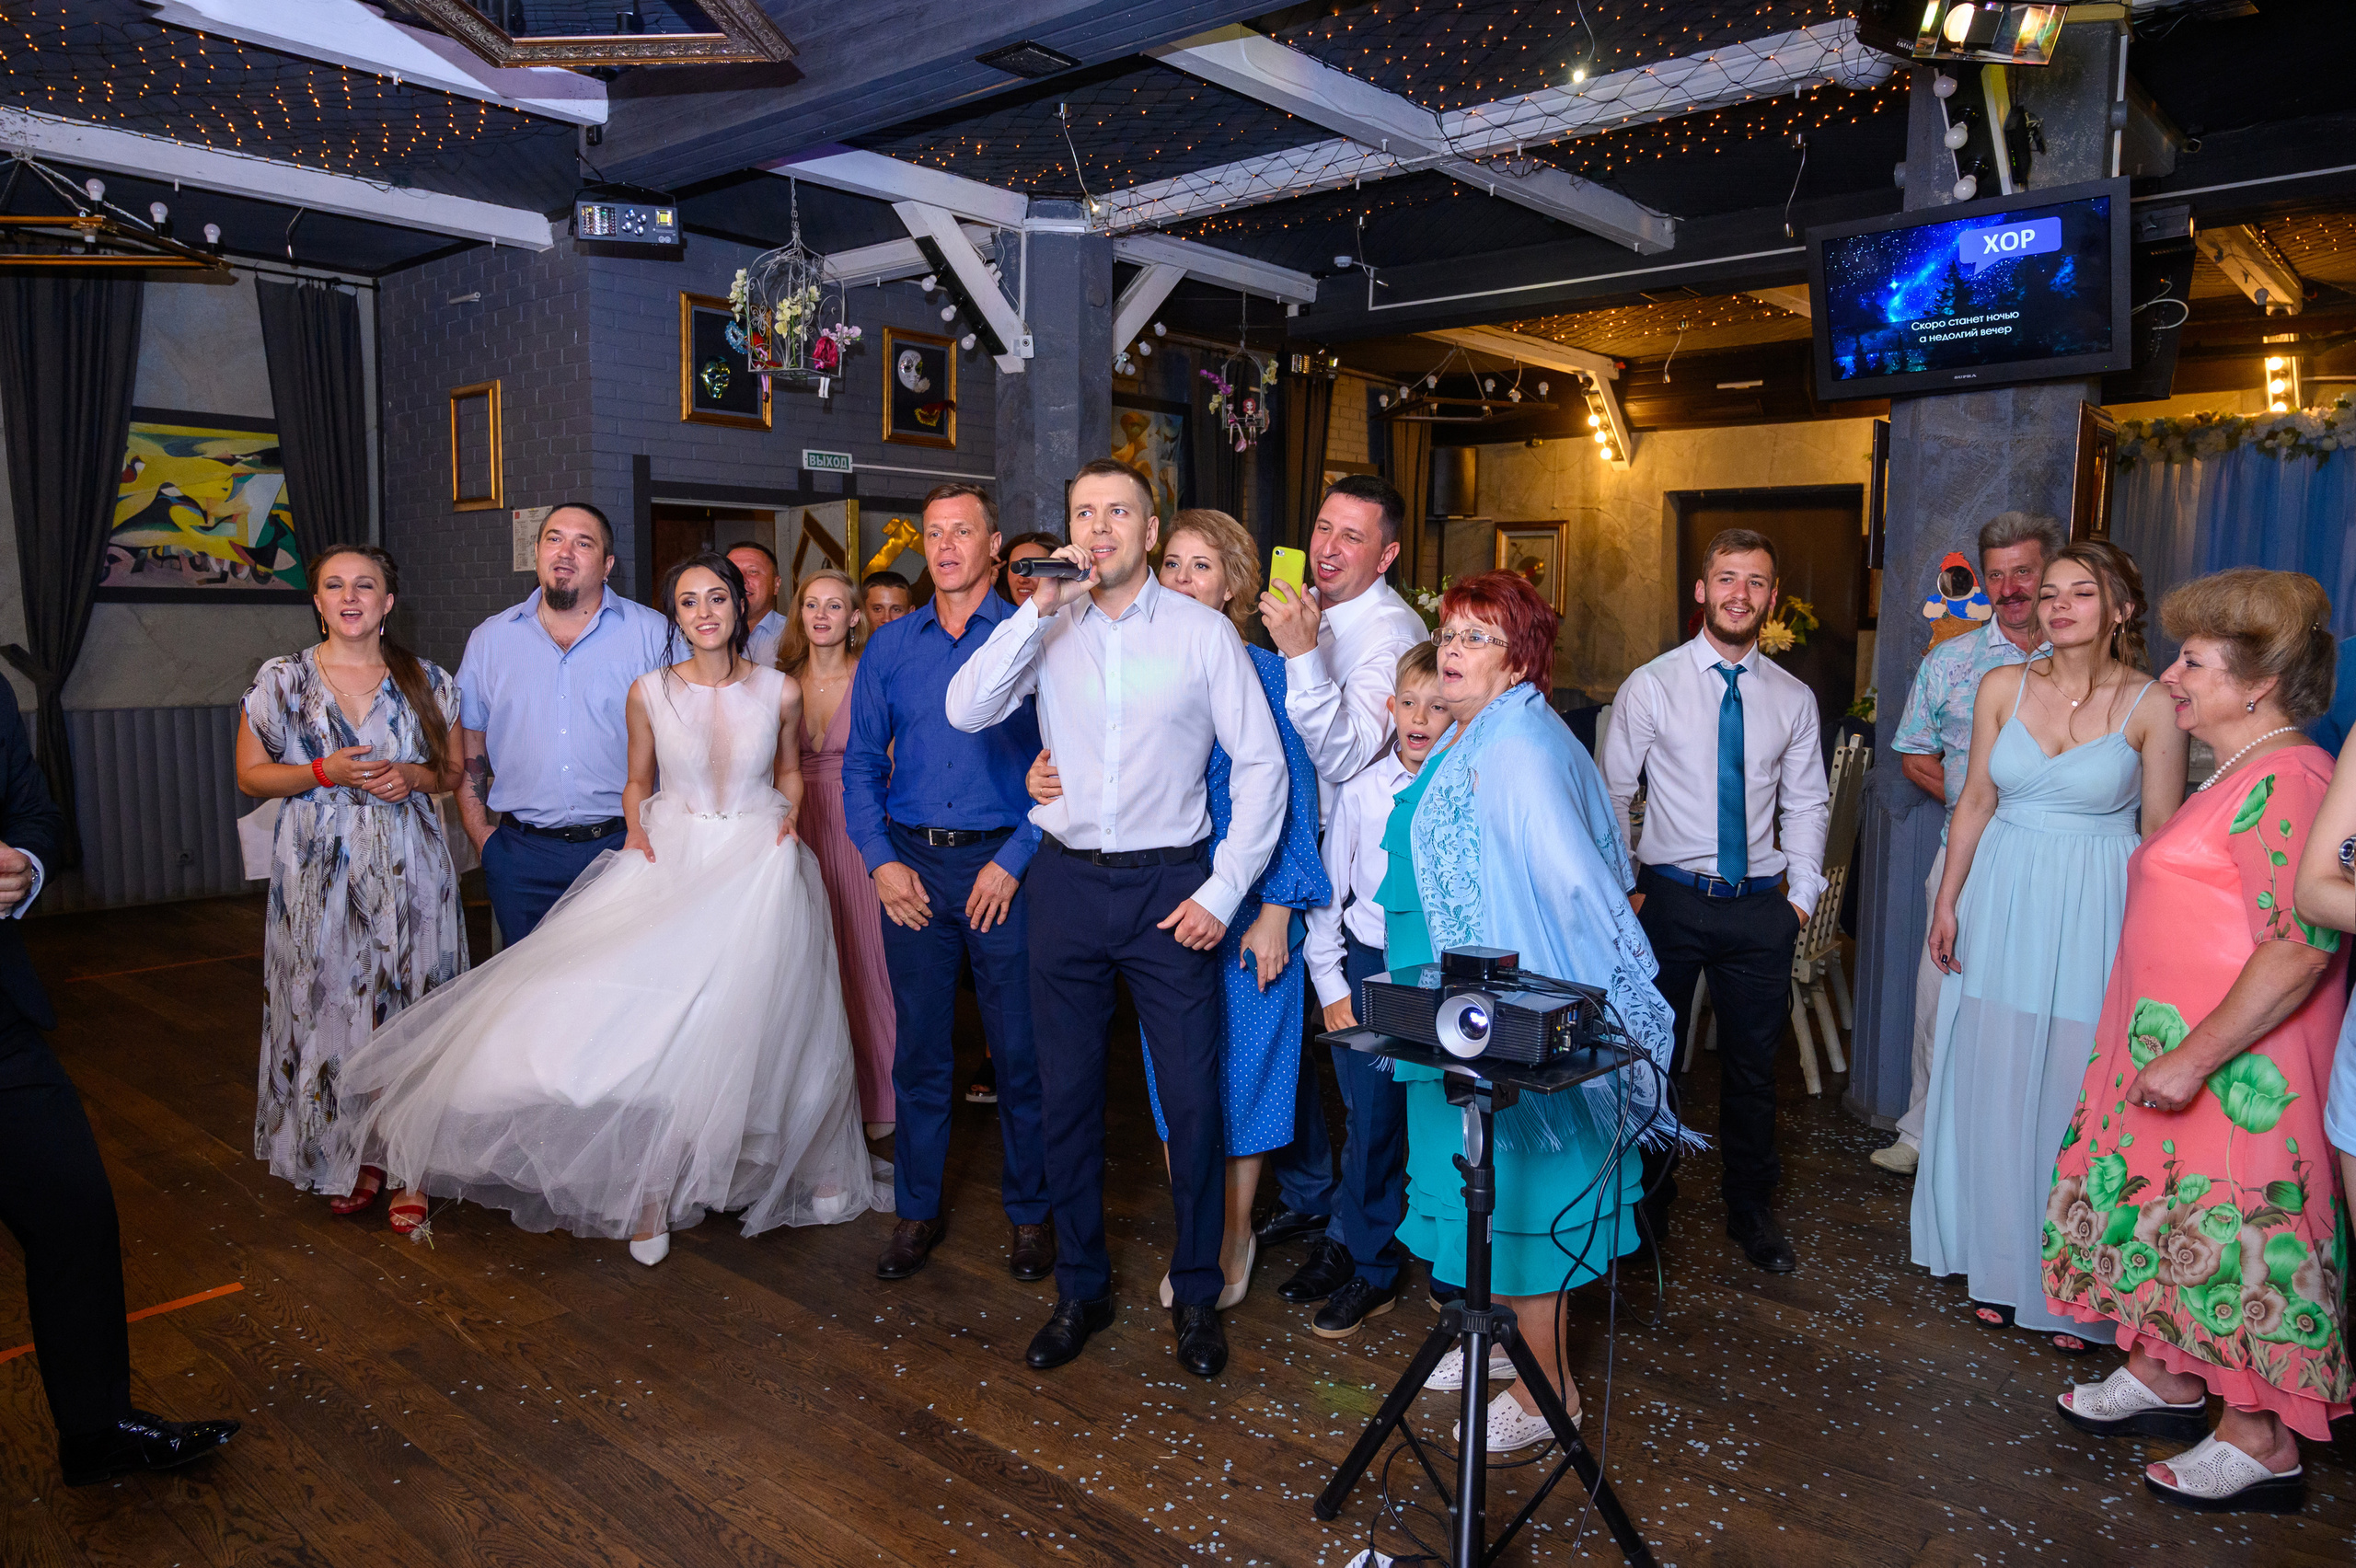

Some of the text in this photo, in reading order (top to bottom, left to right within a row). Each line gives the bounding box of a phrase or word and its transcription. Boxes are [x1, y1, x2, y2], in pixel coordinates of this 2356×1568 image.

[1983, 229, 2036, 255] ХОР
[1911, 311, 2020, 331] Скоро станет ночью
[1929, 328, 1979, 341] недолгий
[1981, 326, 2013, 335] вечер
[809, 455, 848, 469] ВЫХОД
